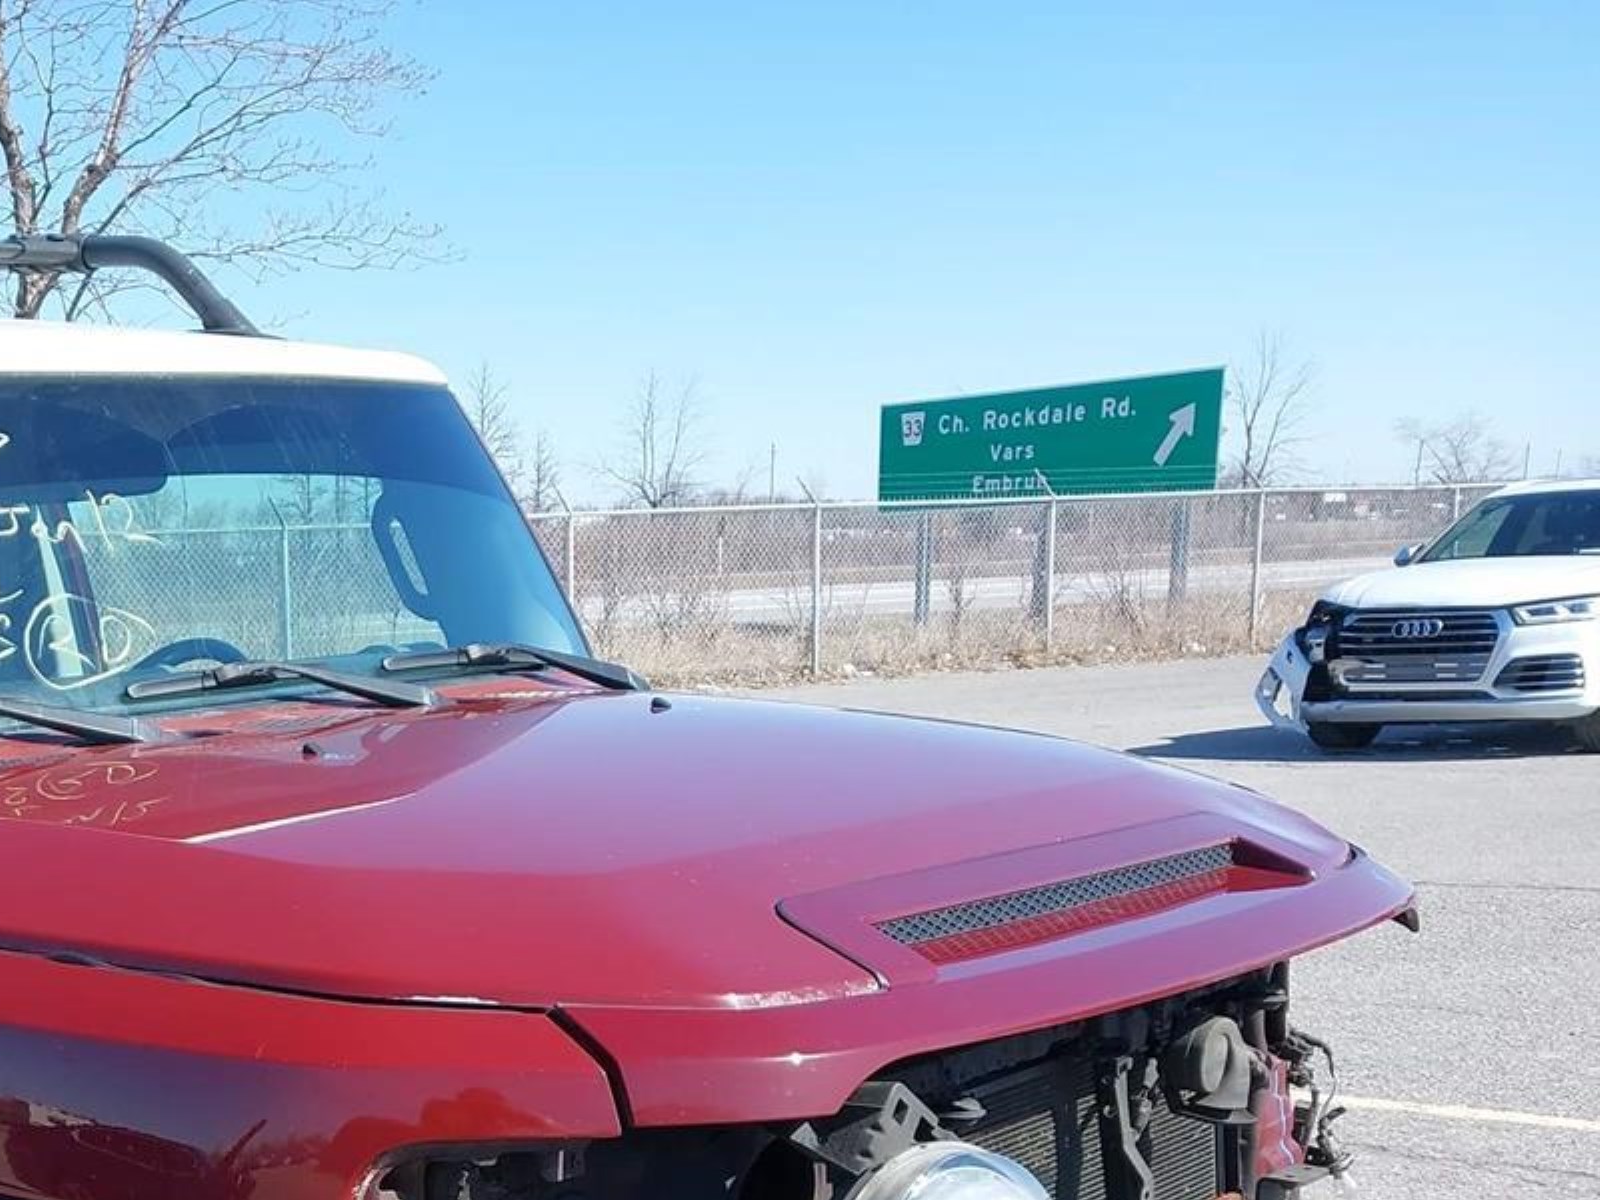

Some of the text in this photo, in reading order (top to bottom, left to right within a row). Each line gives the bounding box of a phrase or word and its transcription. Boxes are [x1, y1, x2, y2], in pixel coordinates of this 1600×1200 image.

[938, 414, 971, 435] Ch.
[983, 402, 1087, 431] Rockdale
[1101, 396, 1137, 419] Rd.
[991, 443, 1035, 462] Vars
